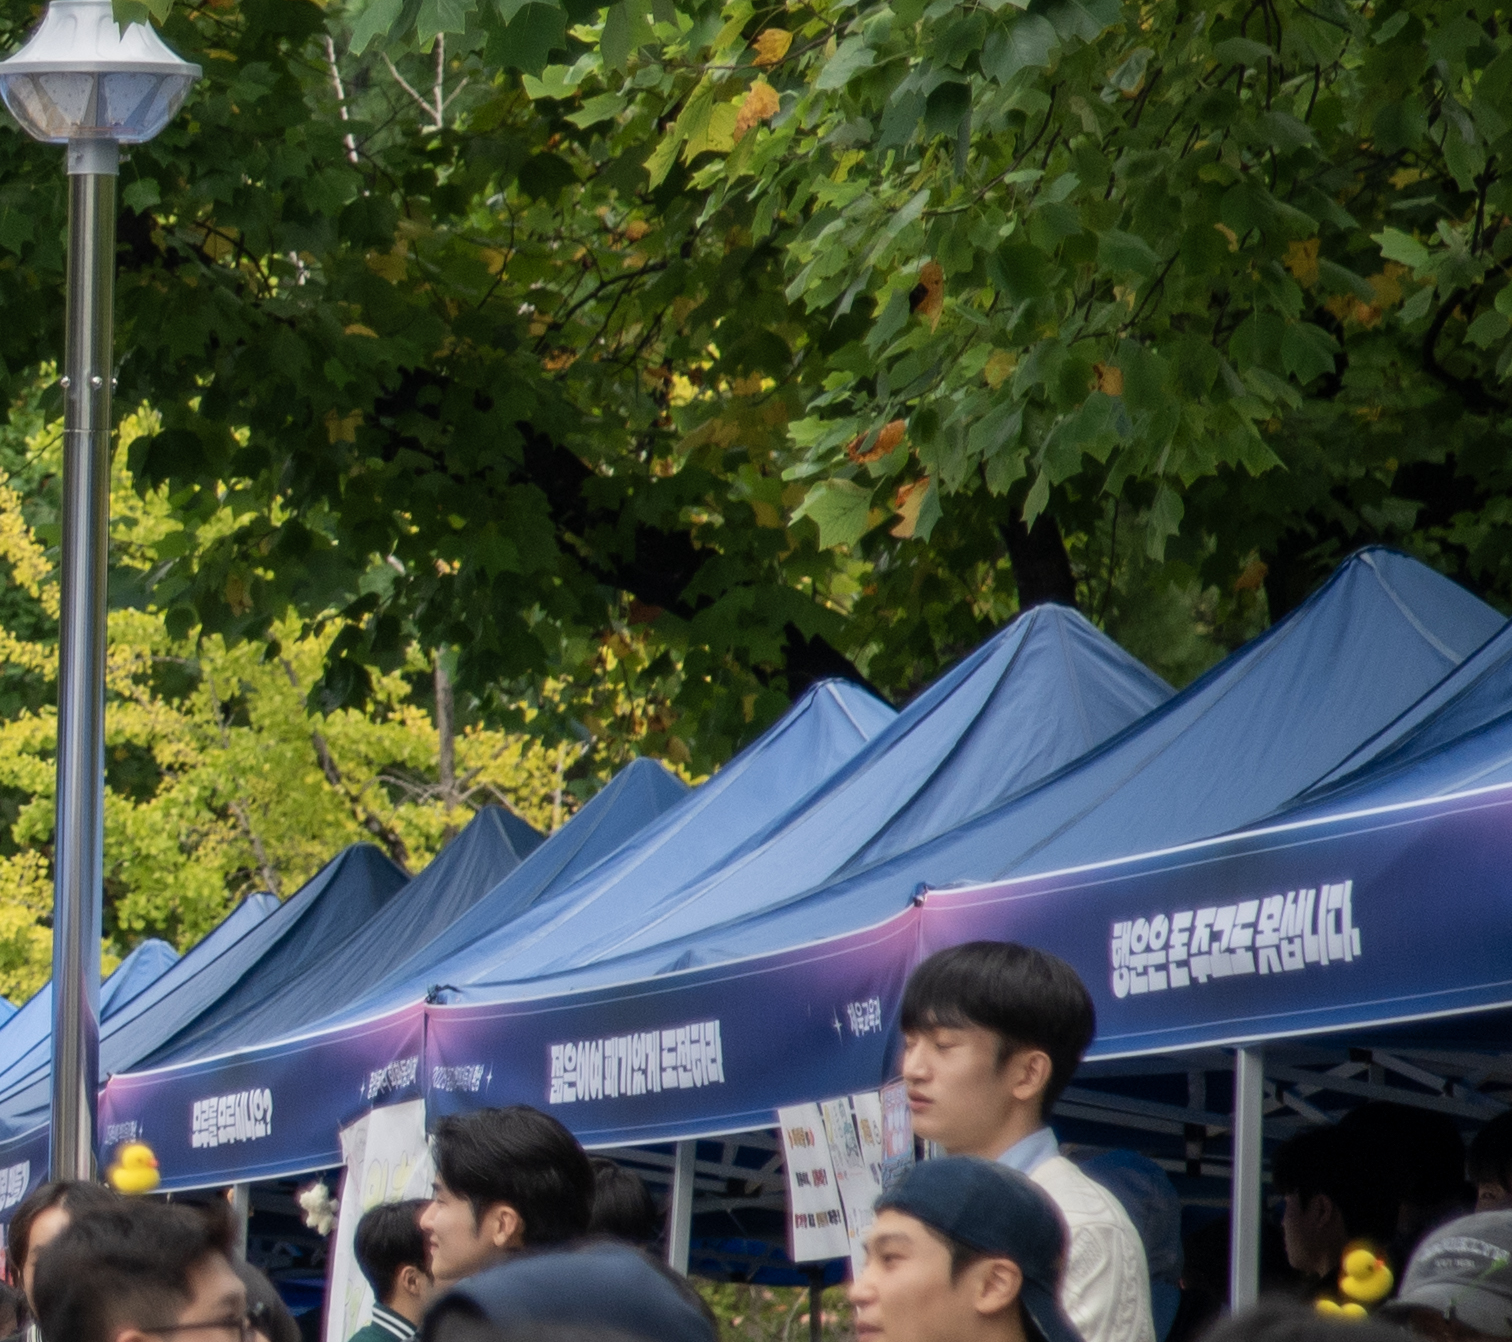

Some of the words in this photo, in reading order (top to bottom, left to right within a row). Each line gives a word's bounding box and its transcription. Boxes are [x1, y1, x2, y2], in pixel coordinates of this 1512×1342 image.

[1112, 914, 1170, 999] 행운은
[1168, 910, 1194, 989] 돈
[1190, 899, 1258, 984] 주고도
[847, 995, 882, 1038] 체육교육과
[549, 1039, 603, 1105] 젊은이여
[604, 1030, 662, 1098] 패기있게
[661, 1019, 725, 1089] 도전하라
[192, 1096, 219, 1149] 모루를
[217, 1087, 273, 1145] 모루시나요?
